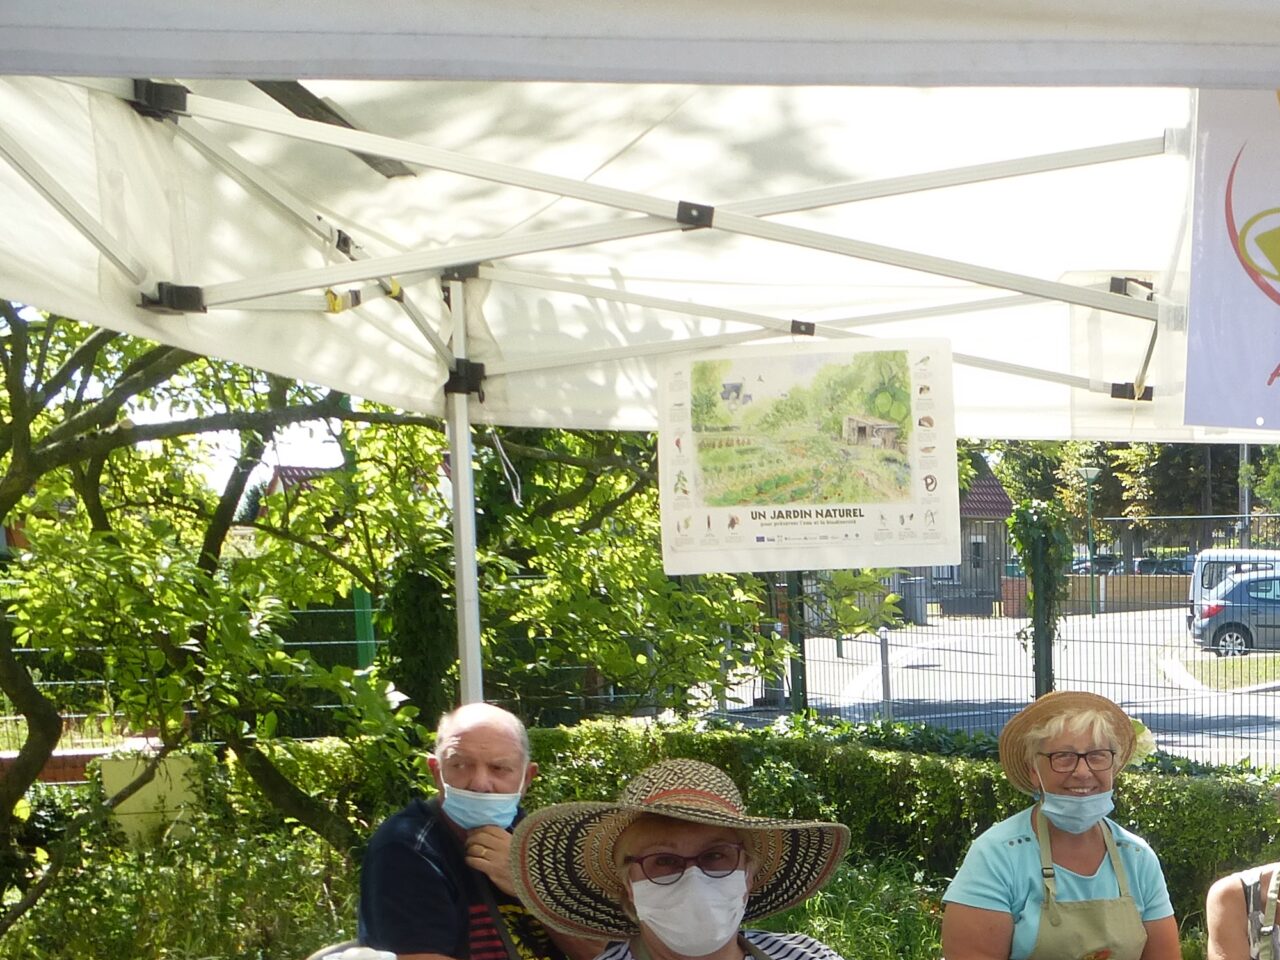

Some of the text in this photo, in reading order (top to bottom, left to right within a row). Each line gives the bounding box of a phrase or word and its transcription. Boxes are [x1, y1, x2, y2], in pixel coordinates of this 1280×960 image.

[750, 508, 865, 520] UN JARDIN NATUREL
